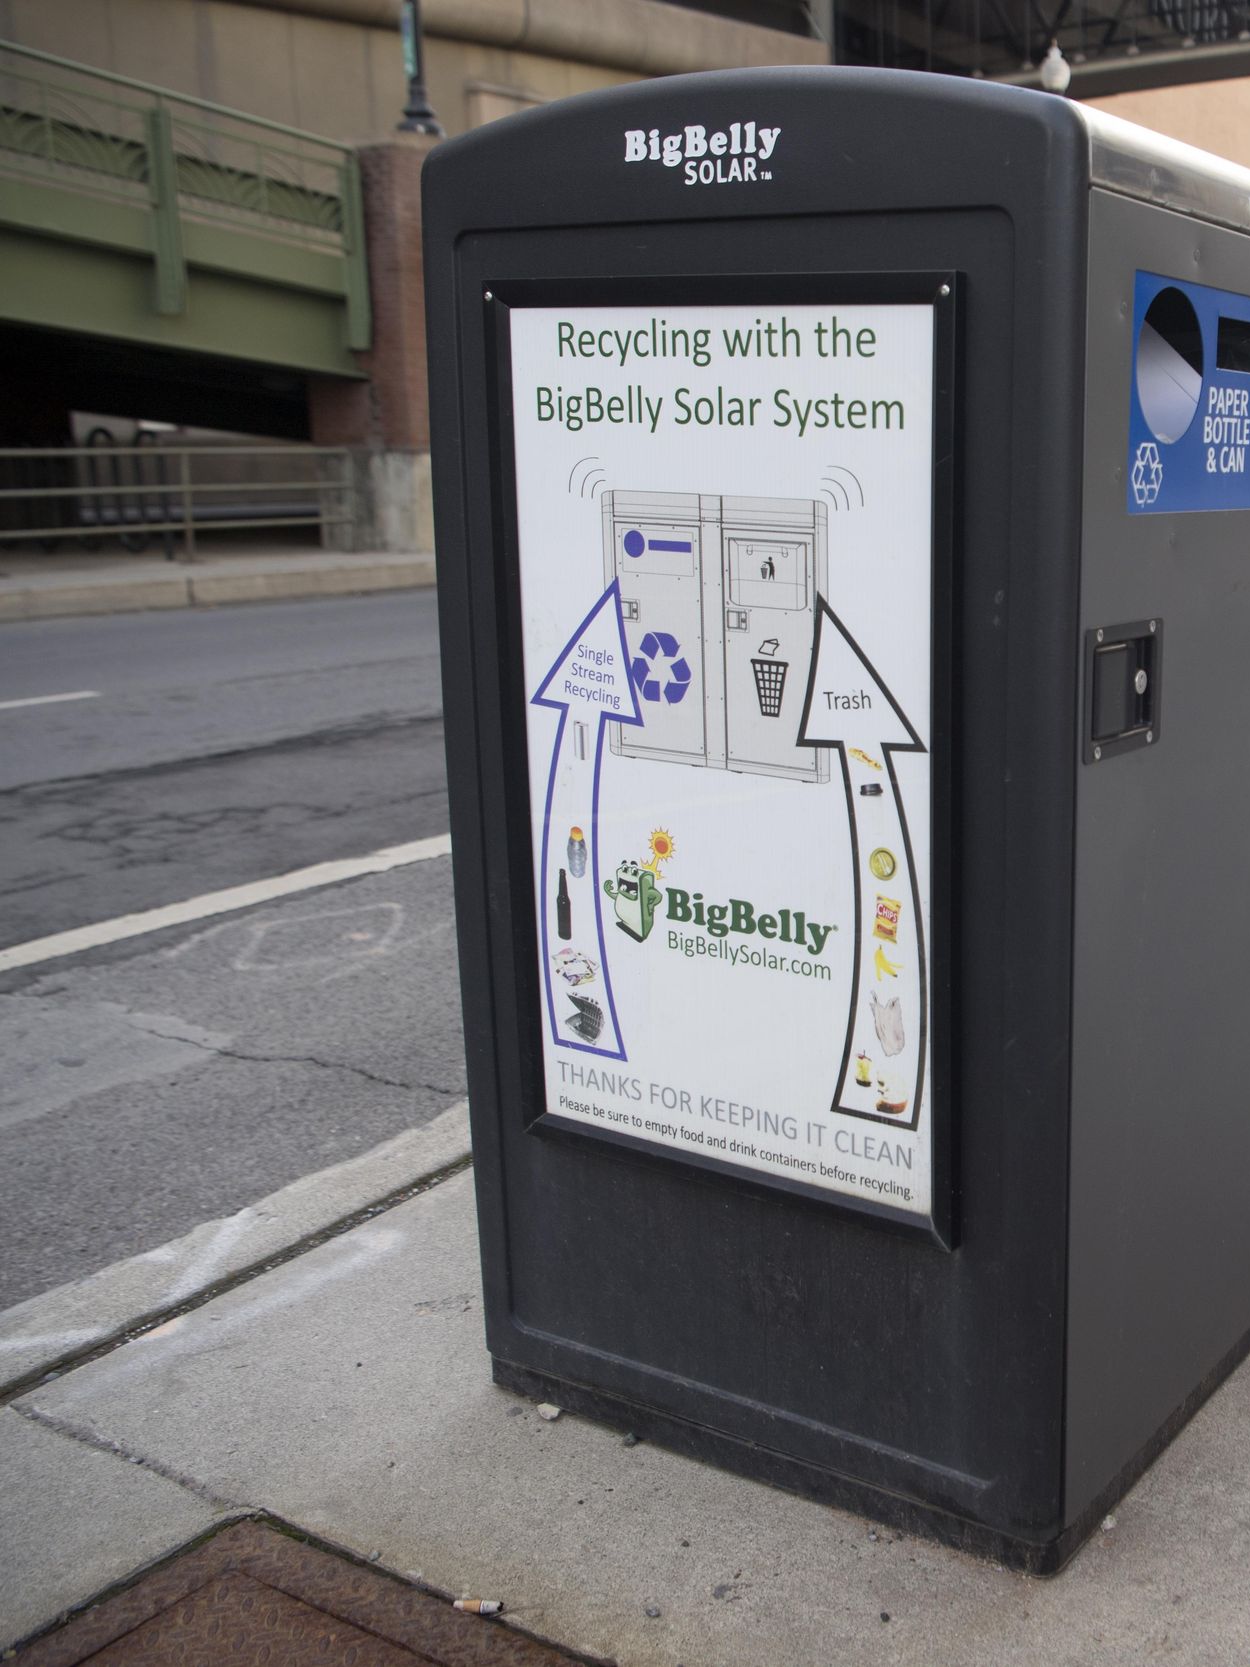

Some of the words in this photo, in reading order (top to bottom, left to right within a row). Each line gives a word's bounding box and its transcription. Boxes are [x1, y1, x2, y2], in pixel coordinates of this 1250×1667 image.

[624, 121, 782, 167] BigBelly
[684, 157, 757, 185] SOLAR
[557, 318, 711, 367] Recycling
[722, 318, 802, 358] with
[814, 315, 877, 358] the
[536, 385, 664, 433] BigBelly
[674, 386, 762, 427] Solar
[773, 389, 905, 437] System
[1208, 386, 1249, 417] PAPER
[1203, 416, 1250, 445] BOTTLE
[1206, 447, 1217, 473] &
[1220, 446, 1245, 473] CAN
[577, 644, 614, 666] Single
[571, 662, 615, 685] Stream
[564, 680, 621, 710] Recycling
[823, 688, 872, 711] Trash
[665, 887, 833, 956] BigBelly
[668, 930, 831, 981] BigBellySolar.com
[557, 1060, 642, 1101] THANKS
[649, 1083, 693, 1114] FOR
[700, 1095, 798, 1140] KEEPING
[807, 1121, 827, 1147] IT
[834, 1129, 913, 1170] CLEAN
[559, 1095, 590, 1114] Please
[593, 1104, 605, 1118] be
[608, 1110, 629, 1124] sure
[632, 1115, 642, 1127] to
[645, 1120, 678, 1139] empty
[680, 1126, 704, 1144] food
[707, 1135, 727, 1150] and
[729, 1139, 757, 1158] drink
[759, 1148, 817, 1174] containers
[820, 1162, 857, 1184] before
[859, 1175, 914, 1200] recycling.
